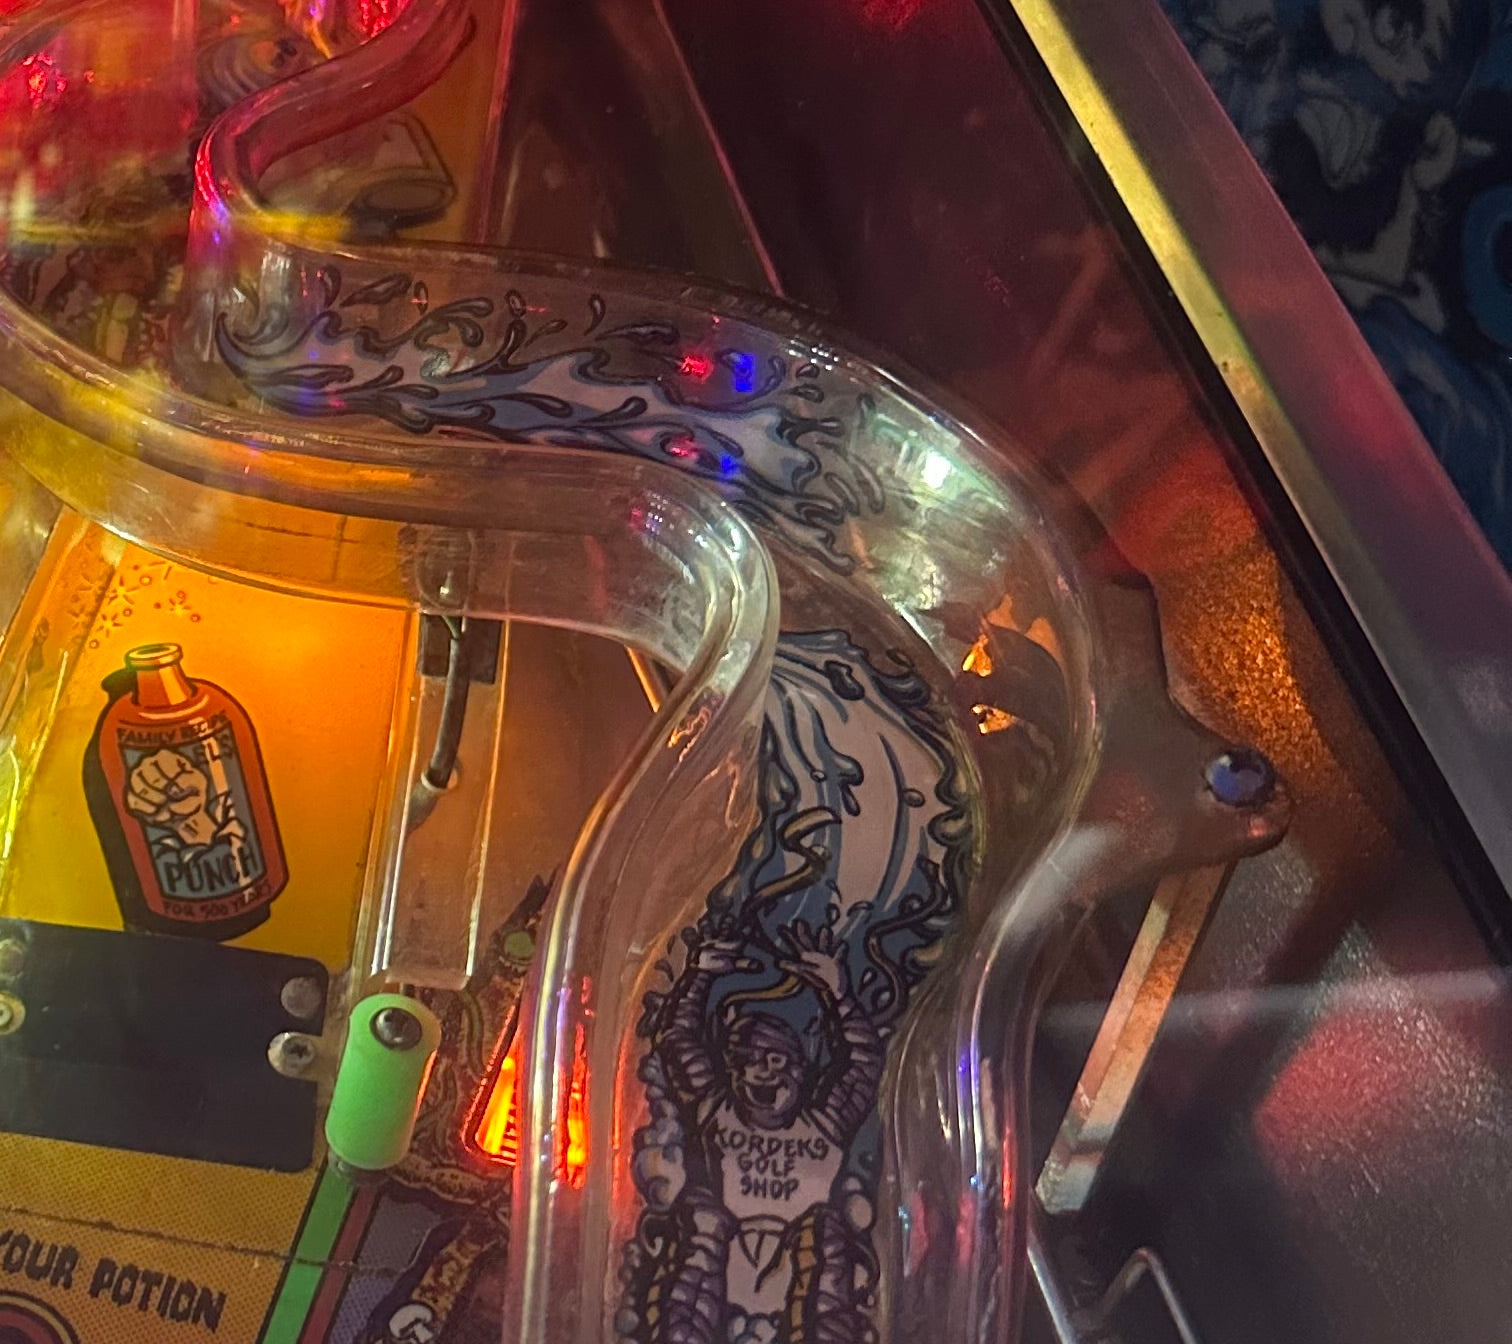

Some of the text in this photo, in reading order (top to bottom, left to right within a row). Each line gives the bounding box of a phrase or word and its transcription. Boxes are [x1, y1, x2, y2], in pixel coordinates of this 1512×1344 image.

[162, 850, 260, 894] PUNCH
[737, 1152, 796, 1178] GOLF
[739, 1174, 800, 1202] SHOP
[88, 1256, 228, 1334] POTION
